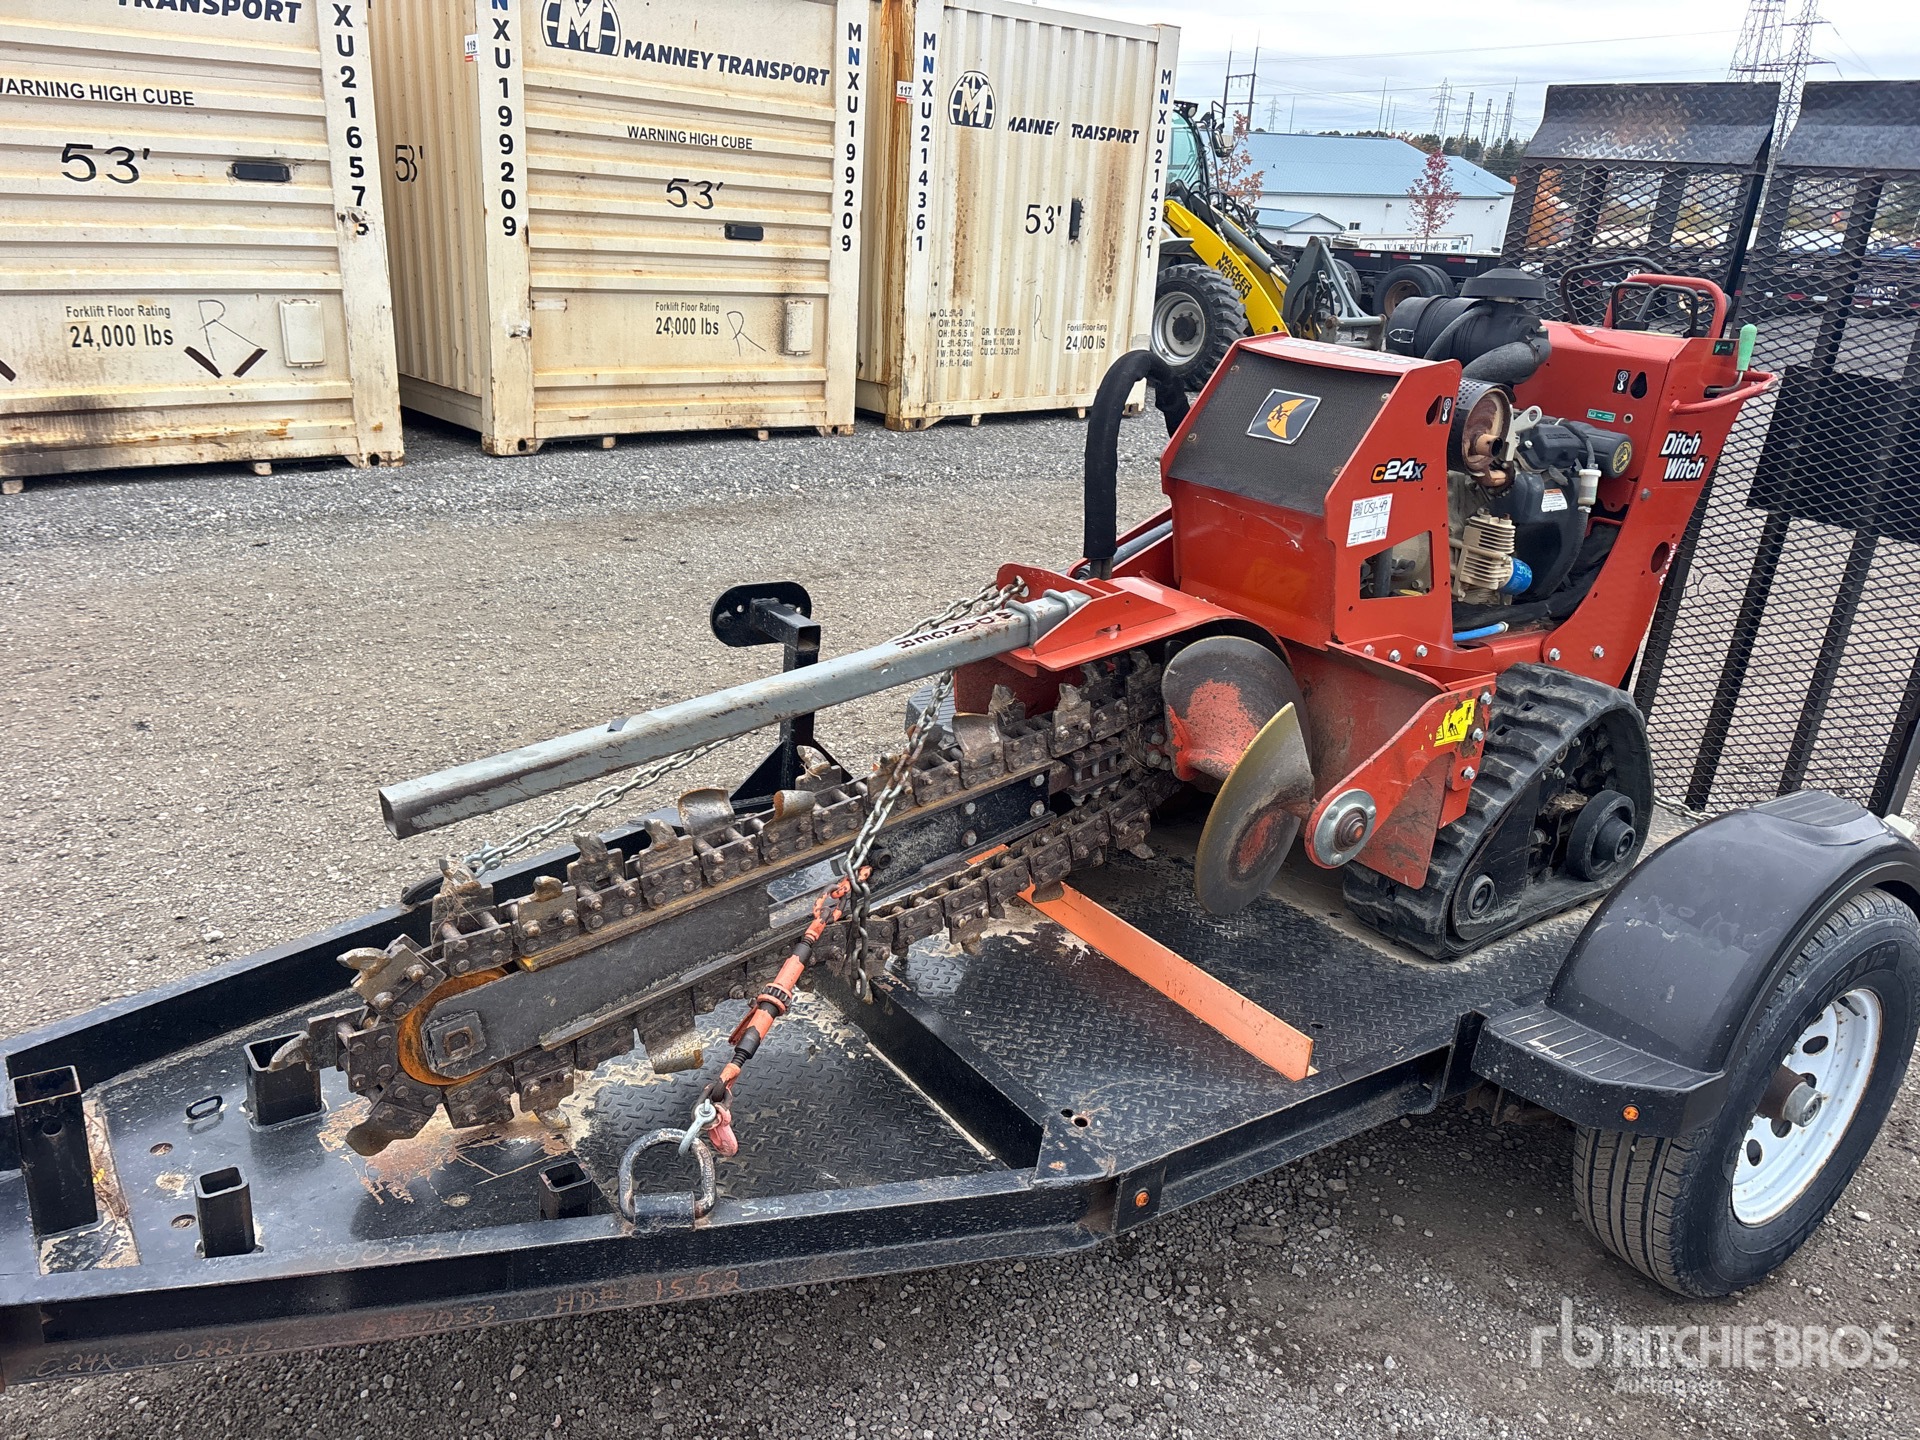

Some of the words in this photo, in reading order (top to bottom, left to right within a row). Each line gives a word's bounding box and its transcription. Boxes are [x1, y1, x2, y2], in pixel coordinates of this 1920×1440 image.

[624, 39, 714, 70] MANNEY
[717, 54, 830, 86] TRANSPORT
[89, 84, 137, 102] HIGH
[142, 88, 195, 106] CUBE
[627, 126, 687, 143] WARNING
[689, 132, 718, 147] HIGH
[721, 135, 753, 150] CUBE
[841, 22, 862, 252] MNXU199209
[915, 32, 936, 251] MNXU214361
[61, 143, 150, 184] 53'
[1147, 69, 1172, 258] MNXU214361
[666, 178, 724, 210] 53'
[1025, 204, 1062, 235] 53'
[1221, 251, 1253, 293] WACKER
[66, 305, 105, 318] Forklift
[107, 305, 134, 318] Floor
[138, 304, 171, 319] Rating
[655, 301, 679, 312] Forklift
[680, 302, 698, 312] Floor
[699, 302, 720, 314] Rating
[70, 325, 136, 352] 24,000
[143, 324, 174, 347] lbs
[655, 317, 696, 338] 24,000
[700, 317, 719, 335] lbs
[1660, 433, 1701, 455] Ditch
[1664, 457, 1705, 480] Witch
[895, 616, 995, 649] DANGER
